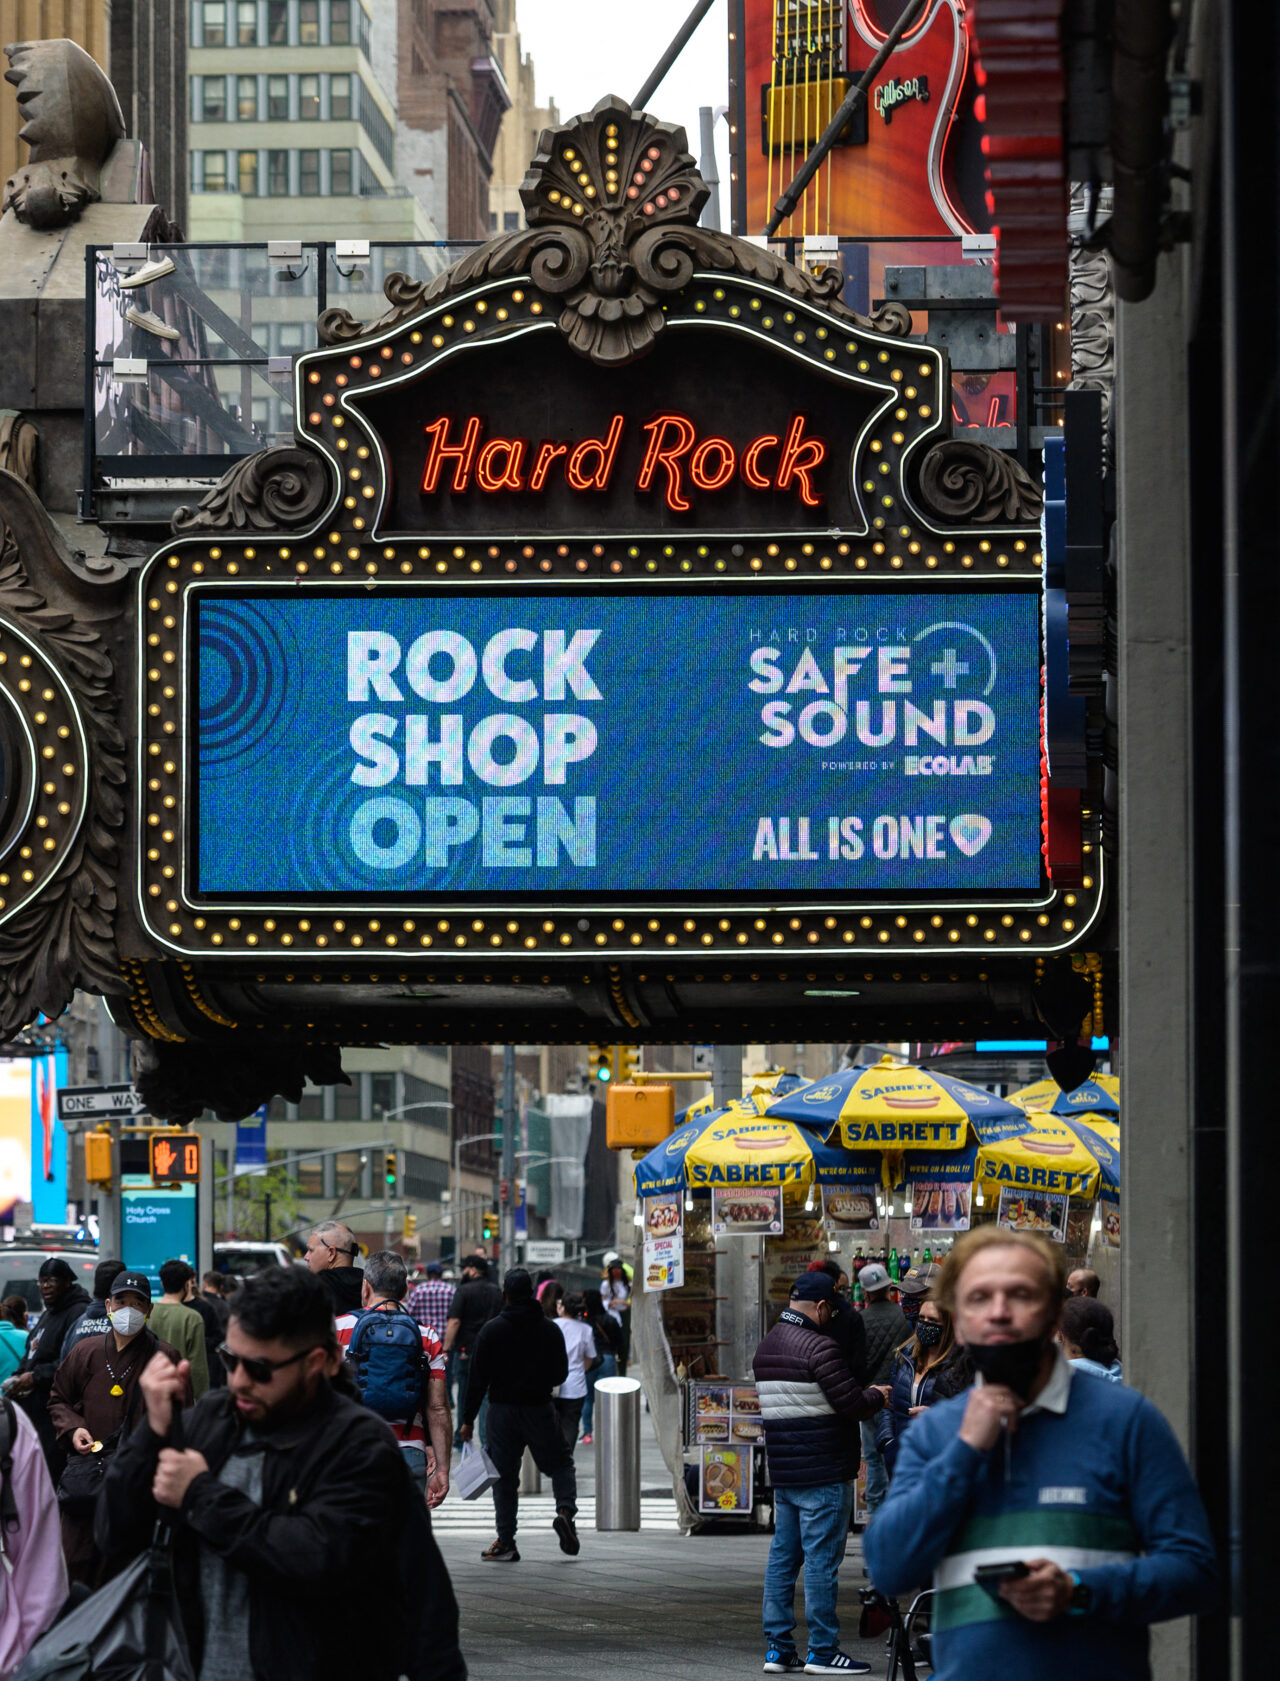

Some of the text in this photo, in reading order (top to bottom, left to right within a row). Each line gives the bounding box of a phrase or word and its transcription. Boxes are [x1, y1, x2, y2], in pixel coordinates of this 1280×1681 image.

[874, 77, 929, 118] Gibson
[422, 414, 826, 511] Hard Rock
[750, 627, 907, 642] HARD ROCK
[347, 628, 604, 702] ROCK
[748, 646, 912, 703] SAFE
[759, 700, 995, 747] SOUND
[349, 714, 598, 789] SHOP
[822, 761, 877, 771] POWERED
[882, 762, 895, 770] BY
[349, 796, 596, 869] OPEN
[753, 815, 946, 861] ALL IS ONE
[65, 1096, 95, 1110] ONE
[712, 1124, 788, 1141] SABRETT
[847, 1123, 961, 1141] SABRETT
[692, 1161, 806, 1183] SABRETT
[945, 1165, 960, 1173] ROLL
[985, 1160, 1094, 1191] SABRETT
[734, 1188, 746, 1197] Hot
[126, 1206, 170, 1217] Holy Cross
[126, 1215, 157, 1224] Church
[82, 1318, 108, 1327] SIGNALS
